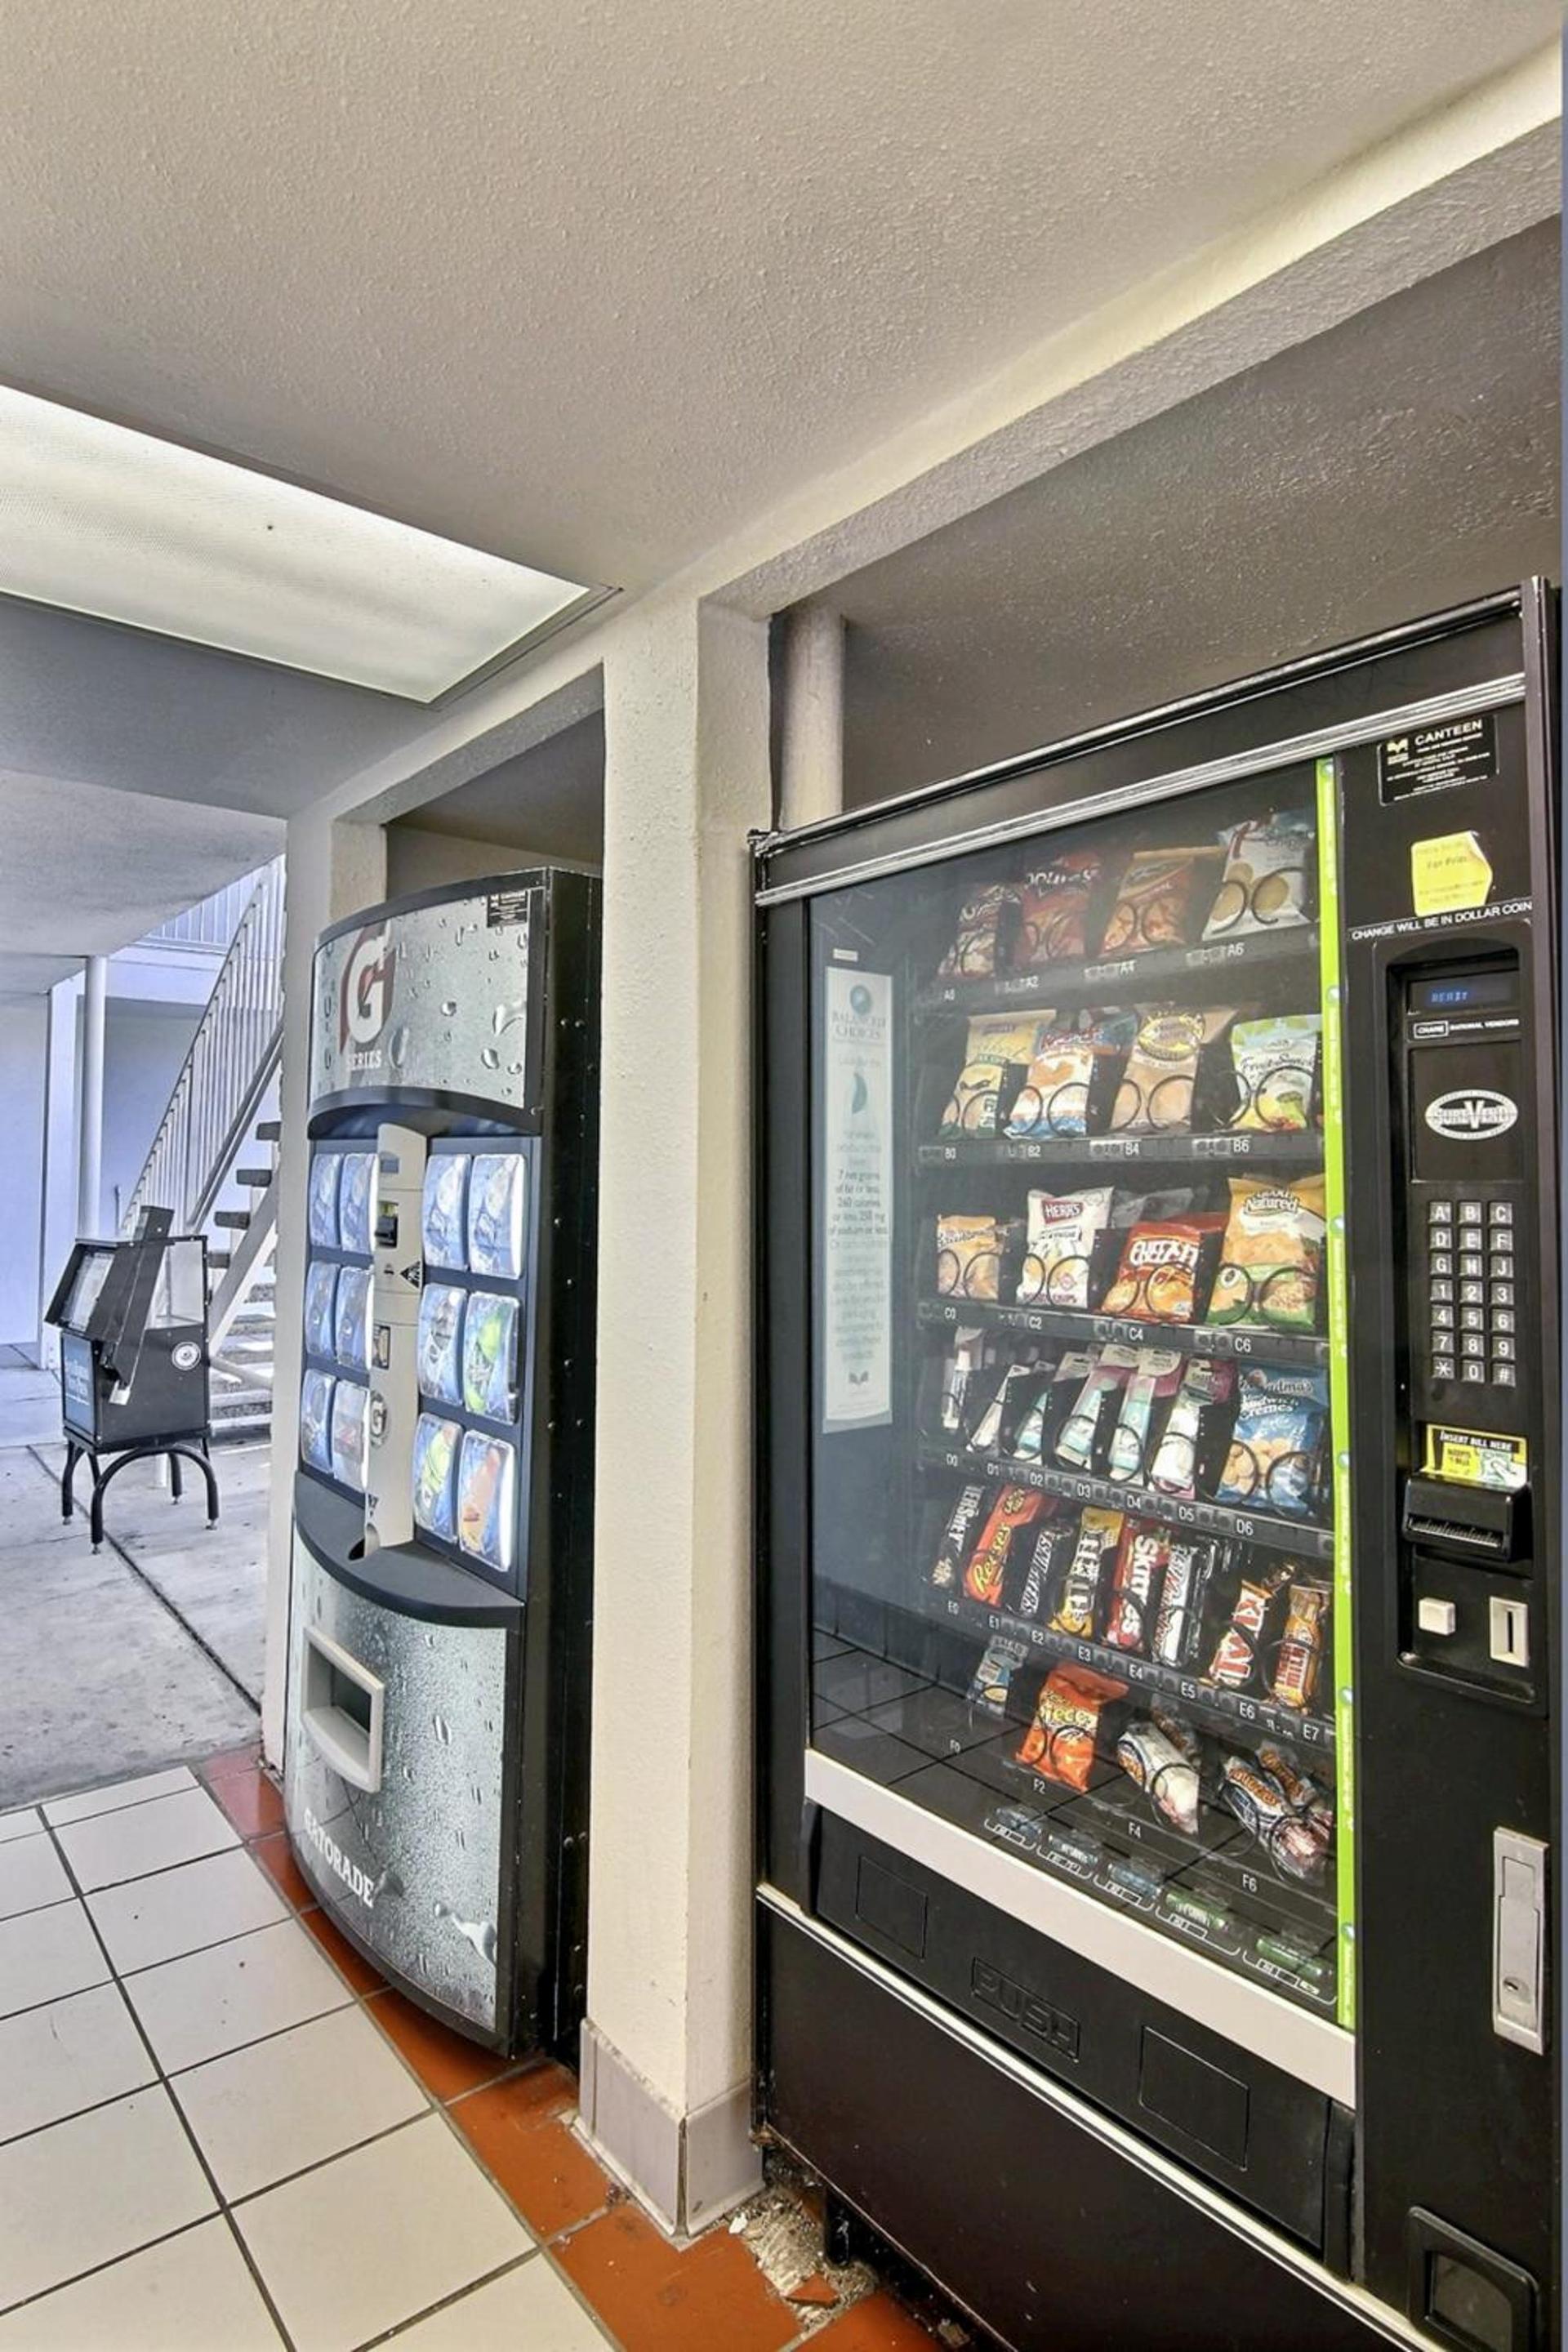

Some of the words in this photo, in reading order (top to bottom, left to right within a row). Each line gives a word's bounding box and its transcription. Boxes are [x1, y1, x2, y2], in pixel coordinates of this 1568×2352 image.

[1414, 719, 1483, 746] CANTEEN
[1352, 925, 1396, 940] CHANGE
[1396, 920, 1422, 933] WILL
[1424, 915, 1440, 928] BE
[1441, 912, 1453, 924] IN
[1454, 905, 1500, 924] DOLLAR
[1502, 901, 1533, 915] COIN
[1028, 1145, 1040, 1157] B2
[1125, 1143, 1139, 1155] B4
[1435, 1206, 1446, 1219] A
[1465, 1206, 1475, 1219] B
[1495, 1206, 1507, 1219] C
[1436, 1232, 1446, 1245] D
[1466, 1233, 1476, 1248] E
[1496, 1234, 1508, 1248] F
[1436, 1258, 1446, 1272] G
[1466, 1260, 1477, 1274] H
[1498, 1261, 1507, 1275] J
[1467, 1285, 1477, 1298] 2
[1498, 1287, 1508, 1301] 3
[1437, 1310, 1446, 1324] 4
[1468, 1312, 1477, 1326] 5
[1498, 1314, 1508, 1329] 6
[1029, 1316, 1042, 1330] C2
[1129, 1327, 1143, 1340] C4
[1235, 1337, 1251, 1352] C6
[1439, 1336, 1447, 1350] 7
[1468, 1339, 1477, 1353] 8
[1499, 1341, 1508, 1356] 9
[1440, 1430, 1468, 1443] INSERT
[1470, 1437, 1487, 1448] BILL
[1489, 1441, 1512, 1451] HERE
[1030, 1472, 1043, 1486] D2
[1077, 1483, 1090, 1498] D3
[1127, 1495, 1142, 1508] D4
[1178, 1506, 1195, 1521] D5
[1236, 1519, 1254, 1535] D6
[1032, 1631, 1044, 1645] E2
[1078, 1646, 1091, 1661] E3
[1129, 1664, 1143, 1680] E4
[1181, 1683, 1196, 1699] E5
[1240, 1704, 1255, 1720] E6
[1303, 1724, 1320, 1740] E7
[1033, 1779, 1045, 1794] F2
[1129, 1822, 1143, 1838] F4
[1242, 1874, 1258, 1892] F6
[303, 1807, 374, 1909] GATORADE
